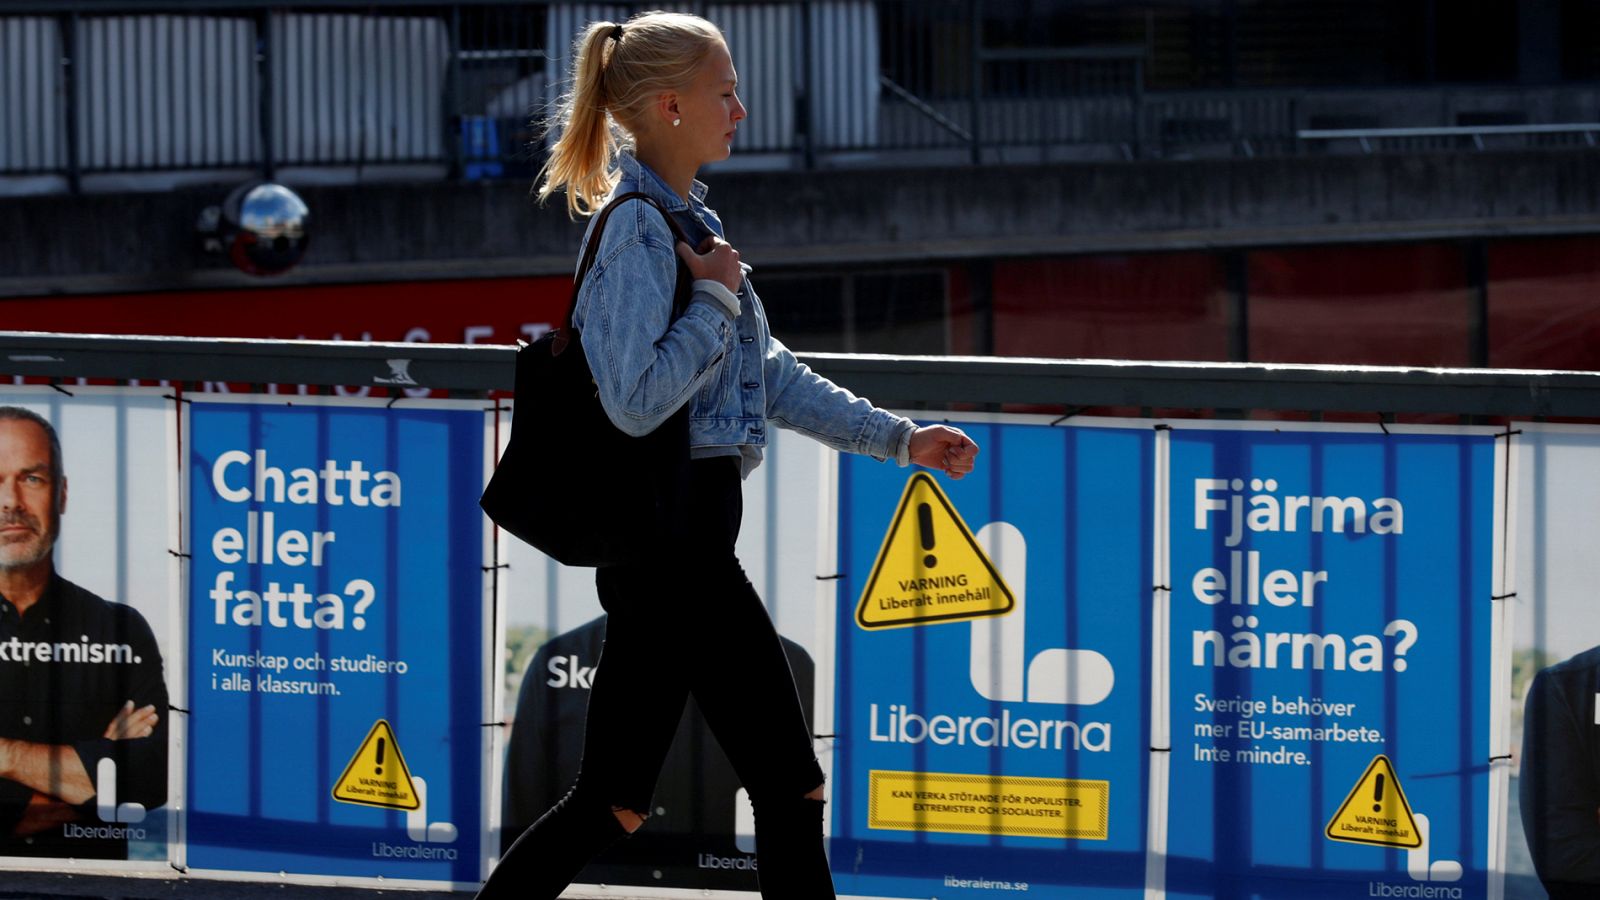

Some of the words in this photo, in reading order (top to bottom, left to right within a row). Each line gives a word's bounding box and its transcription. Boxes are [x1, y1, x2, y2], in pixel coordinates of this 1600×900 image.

[212, 449, 402, 507] Chatta
[1194, 478, 1404, 547] Fjärma
[212, 511, 335, 566] eller
[899, 574, 968, 592] VARNING
[1192, 550, 1328, 607] eller
[209, 571, 375, 631] fatta?
[879, 592, 932, 611] Liberalt
[937, 587, 990, 605] innehåll
[1193, 615, 1418, 672] närma?
[213, 649, 288, 673] Kunskap
[293, 652, 325, 670] och
[330, 654, 408, 674] studiero
[212, 674, 217, 690] i
[221, 674, 251, 691] alla
[257, 675, 341, 695] klassrum.
[1194, 693, 1266, 718] Sverige
[1272, 695, 1355, 717] behöver
[869, 703, 1111, 752] Liberalerna
[1194, 724, 1232, 738] mer
[1238, 721, 1386, 743] EU-samarbete.
[1194, 743, 1230, 762] Inte
[1236, 746, 1311, 765] mindre.
[346, 785, 376, 797] Liberalt
[359, 778, 397, 790] VARNING
[891, 790, 913, 799] KAN
[915, 791, 946, 801] VERKA
[949, 791, 999, 804] STÖTANDE
[1002, 793, 1021, 805] FÖR
[913, 803, 976, 815] EXTREMISTER
[979, 805, 999, 816] OCH
[1002, 806, 1063, 818] SOCIALISTER.
[1355, 815, 1397, 827] VARNING
[64, 823, 146, 840] Liberalerna
[1341, 823, 1373, 834] Liberalt
[372, 842, 457, 860] Liberalerna
[944, 875, 1029, 891] liberalerna.se
[1369, 881, 1462, 899] Liberalerna
